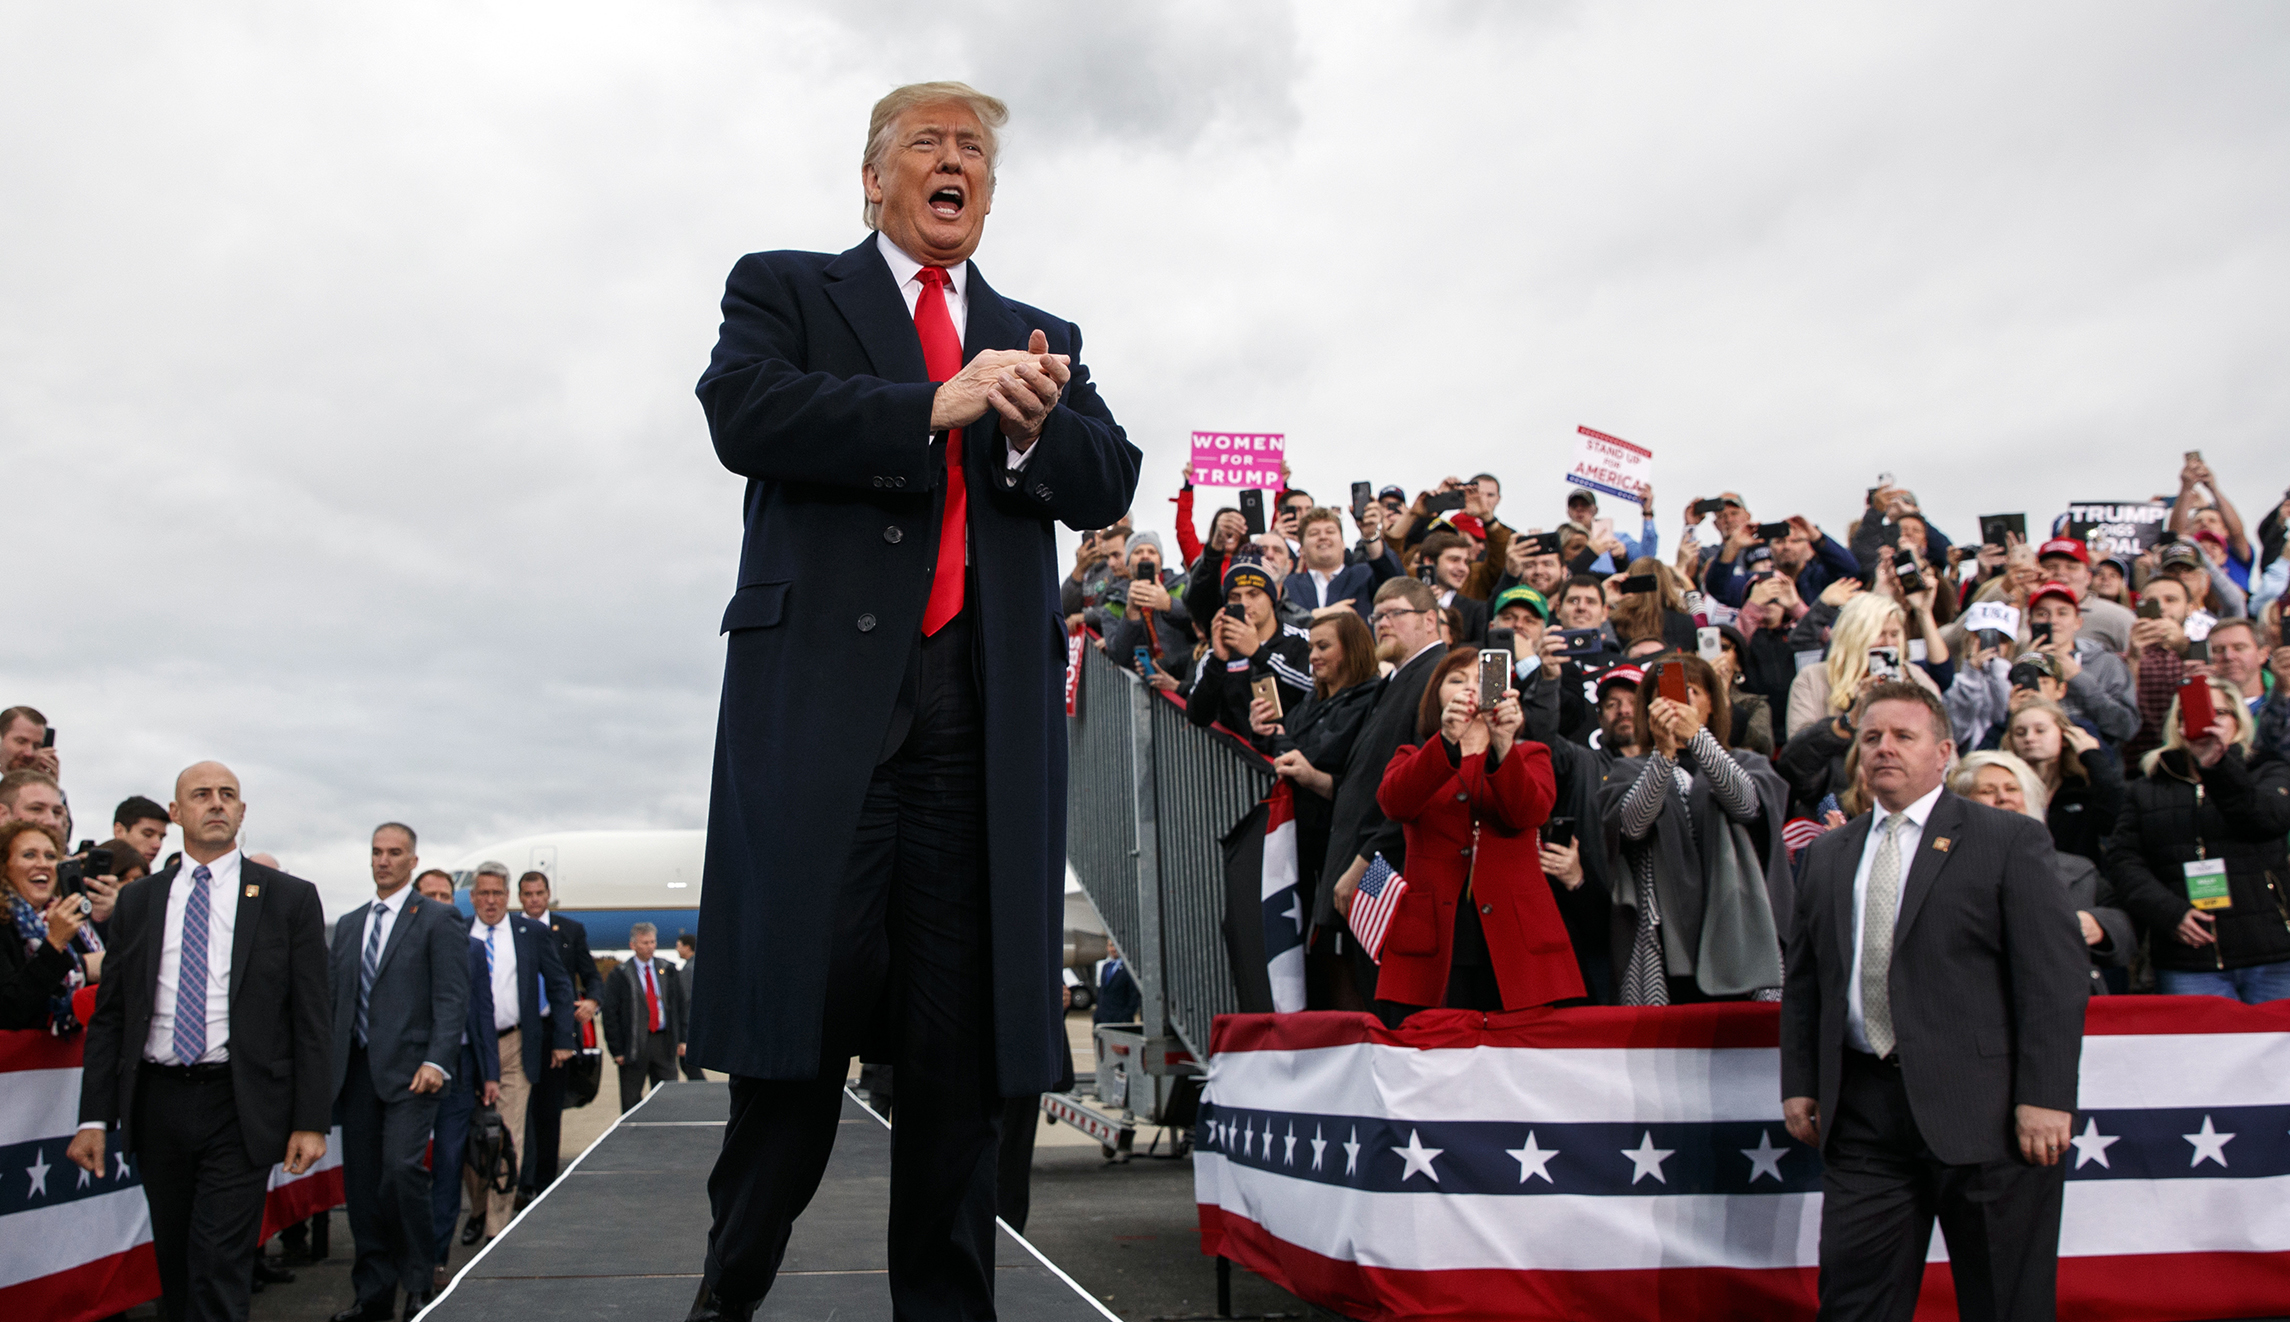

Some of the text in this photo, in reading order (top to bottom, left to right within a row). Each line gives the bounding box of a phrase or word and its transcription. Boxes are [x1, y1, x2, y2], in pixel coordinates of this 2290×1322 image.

[1193, 434, 1283, 451] WOMEN
[1220, 454, 1254, 466] FOR
[1587, 440, 1640, 465] STAND UP
[1194, 468, 1279, 486] TRUMP
[1574, 462, 1643, 491] AMERICA
[2069, 505, 2165, 523] TRUMP
